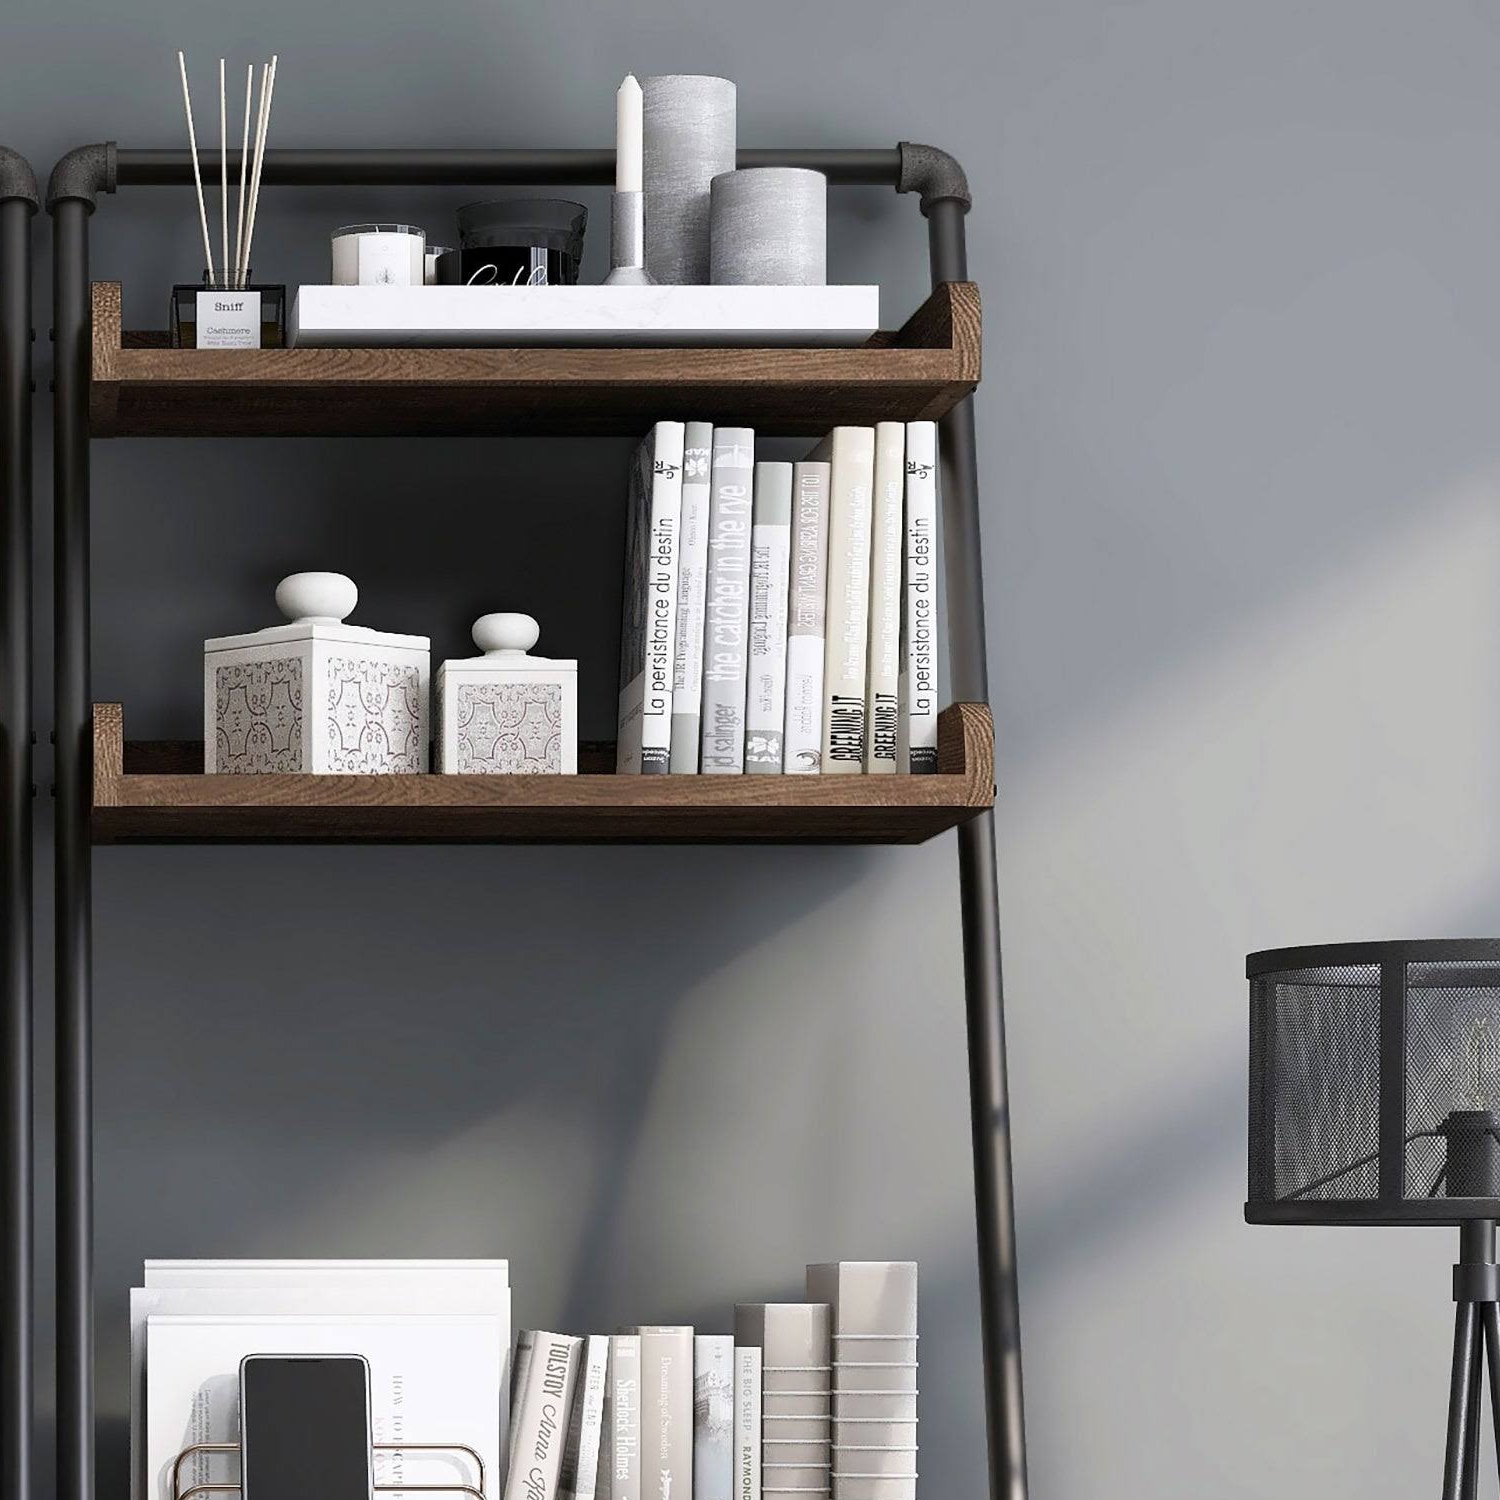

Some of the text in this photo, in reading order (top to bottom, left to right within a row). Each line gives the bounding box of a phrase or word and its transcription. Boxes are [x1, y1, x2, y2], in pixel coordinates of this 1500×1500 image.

[214, 302, 244, 312] Sniff
[680, 567, 691, 606] Language
[706, 484, 747, 682] the catcher in the rye
[644, 517, 673, 717] La persistance du destin
[676, 608, 690, 661] Programming
[907, 517, 932, 717] La persistance du destin
[674, 676, 684, 691] The
[831, 693, 862, 708] IT
[875, 692, 897, 705] IT
[704, 702, 741, 770] jd salinger
[830, 709, 863, 763] GREENING
[874, 705, 898, 762] GREENING
[392, 1375, 404, 1406] HOW
[542, 1342, 571, 1399] TOLSTOY
[589, 1364, 601, 1391] AFTER
[742, 1354, 753, 1431] THE BIG SLEEP
[392, 1415, 404, 1432] TO
[533, 1403, 558, 1461] Anna
[585, 1408, 597, 1427] END
[614, 1378, 637, 1434] Sherlock
[656, 1356, 672, 1460] Dreaming of Sweden
[614, 1436, 636, 1481] Holmes
